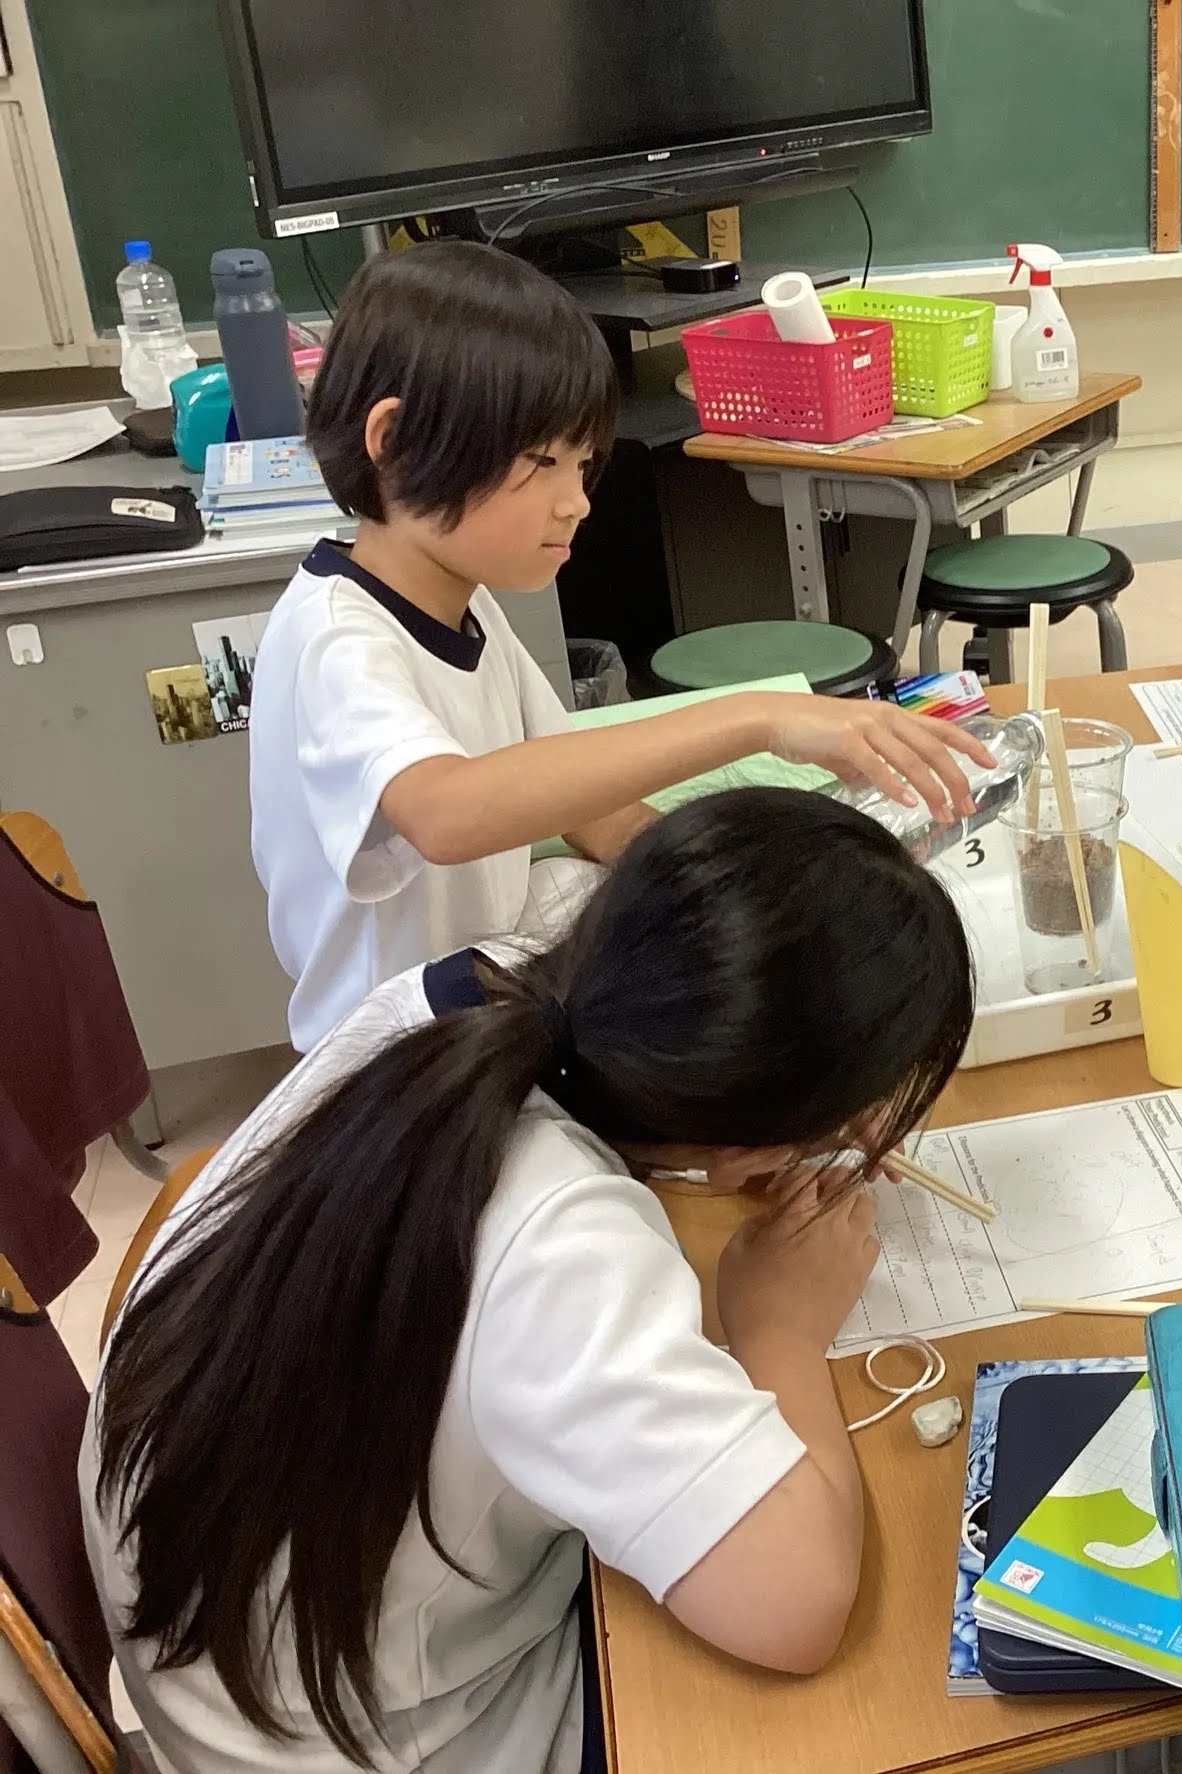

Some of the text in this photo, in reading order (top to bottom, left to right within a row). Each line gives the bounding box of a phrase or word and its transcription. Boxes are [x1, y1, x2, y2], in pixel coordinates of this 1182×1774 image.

[221, 719, 250, 732] CHIC
[965, 838, 986, 867] 3
[1090, 999, 1112, 1026] 3
